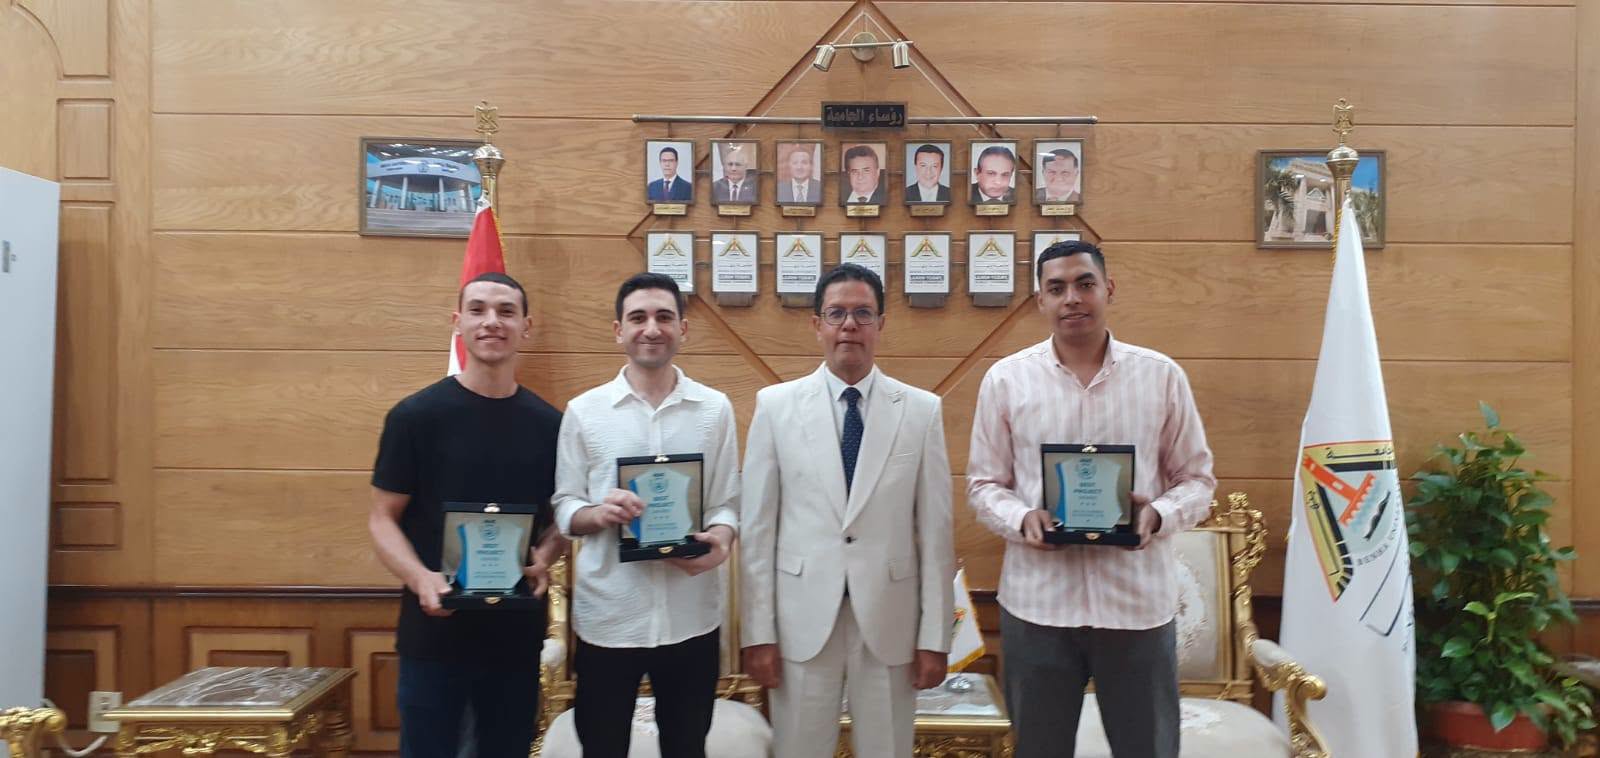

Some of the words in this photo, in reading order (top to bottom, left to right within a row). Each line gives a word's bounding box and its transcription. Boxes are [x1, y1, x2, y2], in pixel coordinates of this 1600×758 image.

[827, 107, 865, 126] الجامعة
[868, 107, 903, 125] رؤساء
[1357, 544, 1390, 567] BENHA
